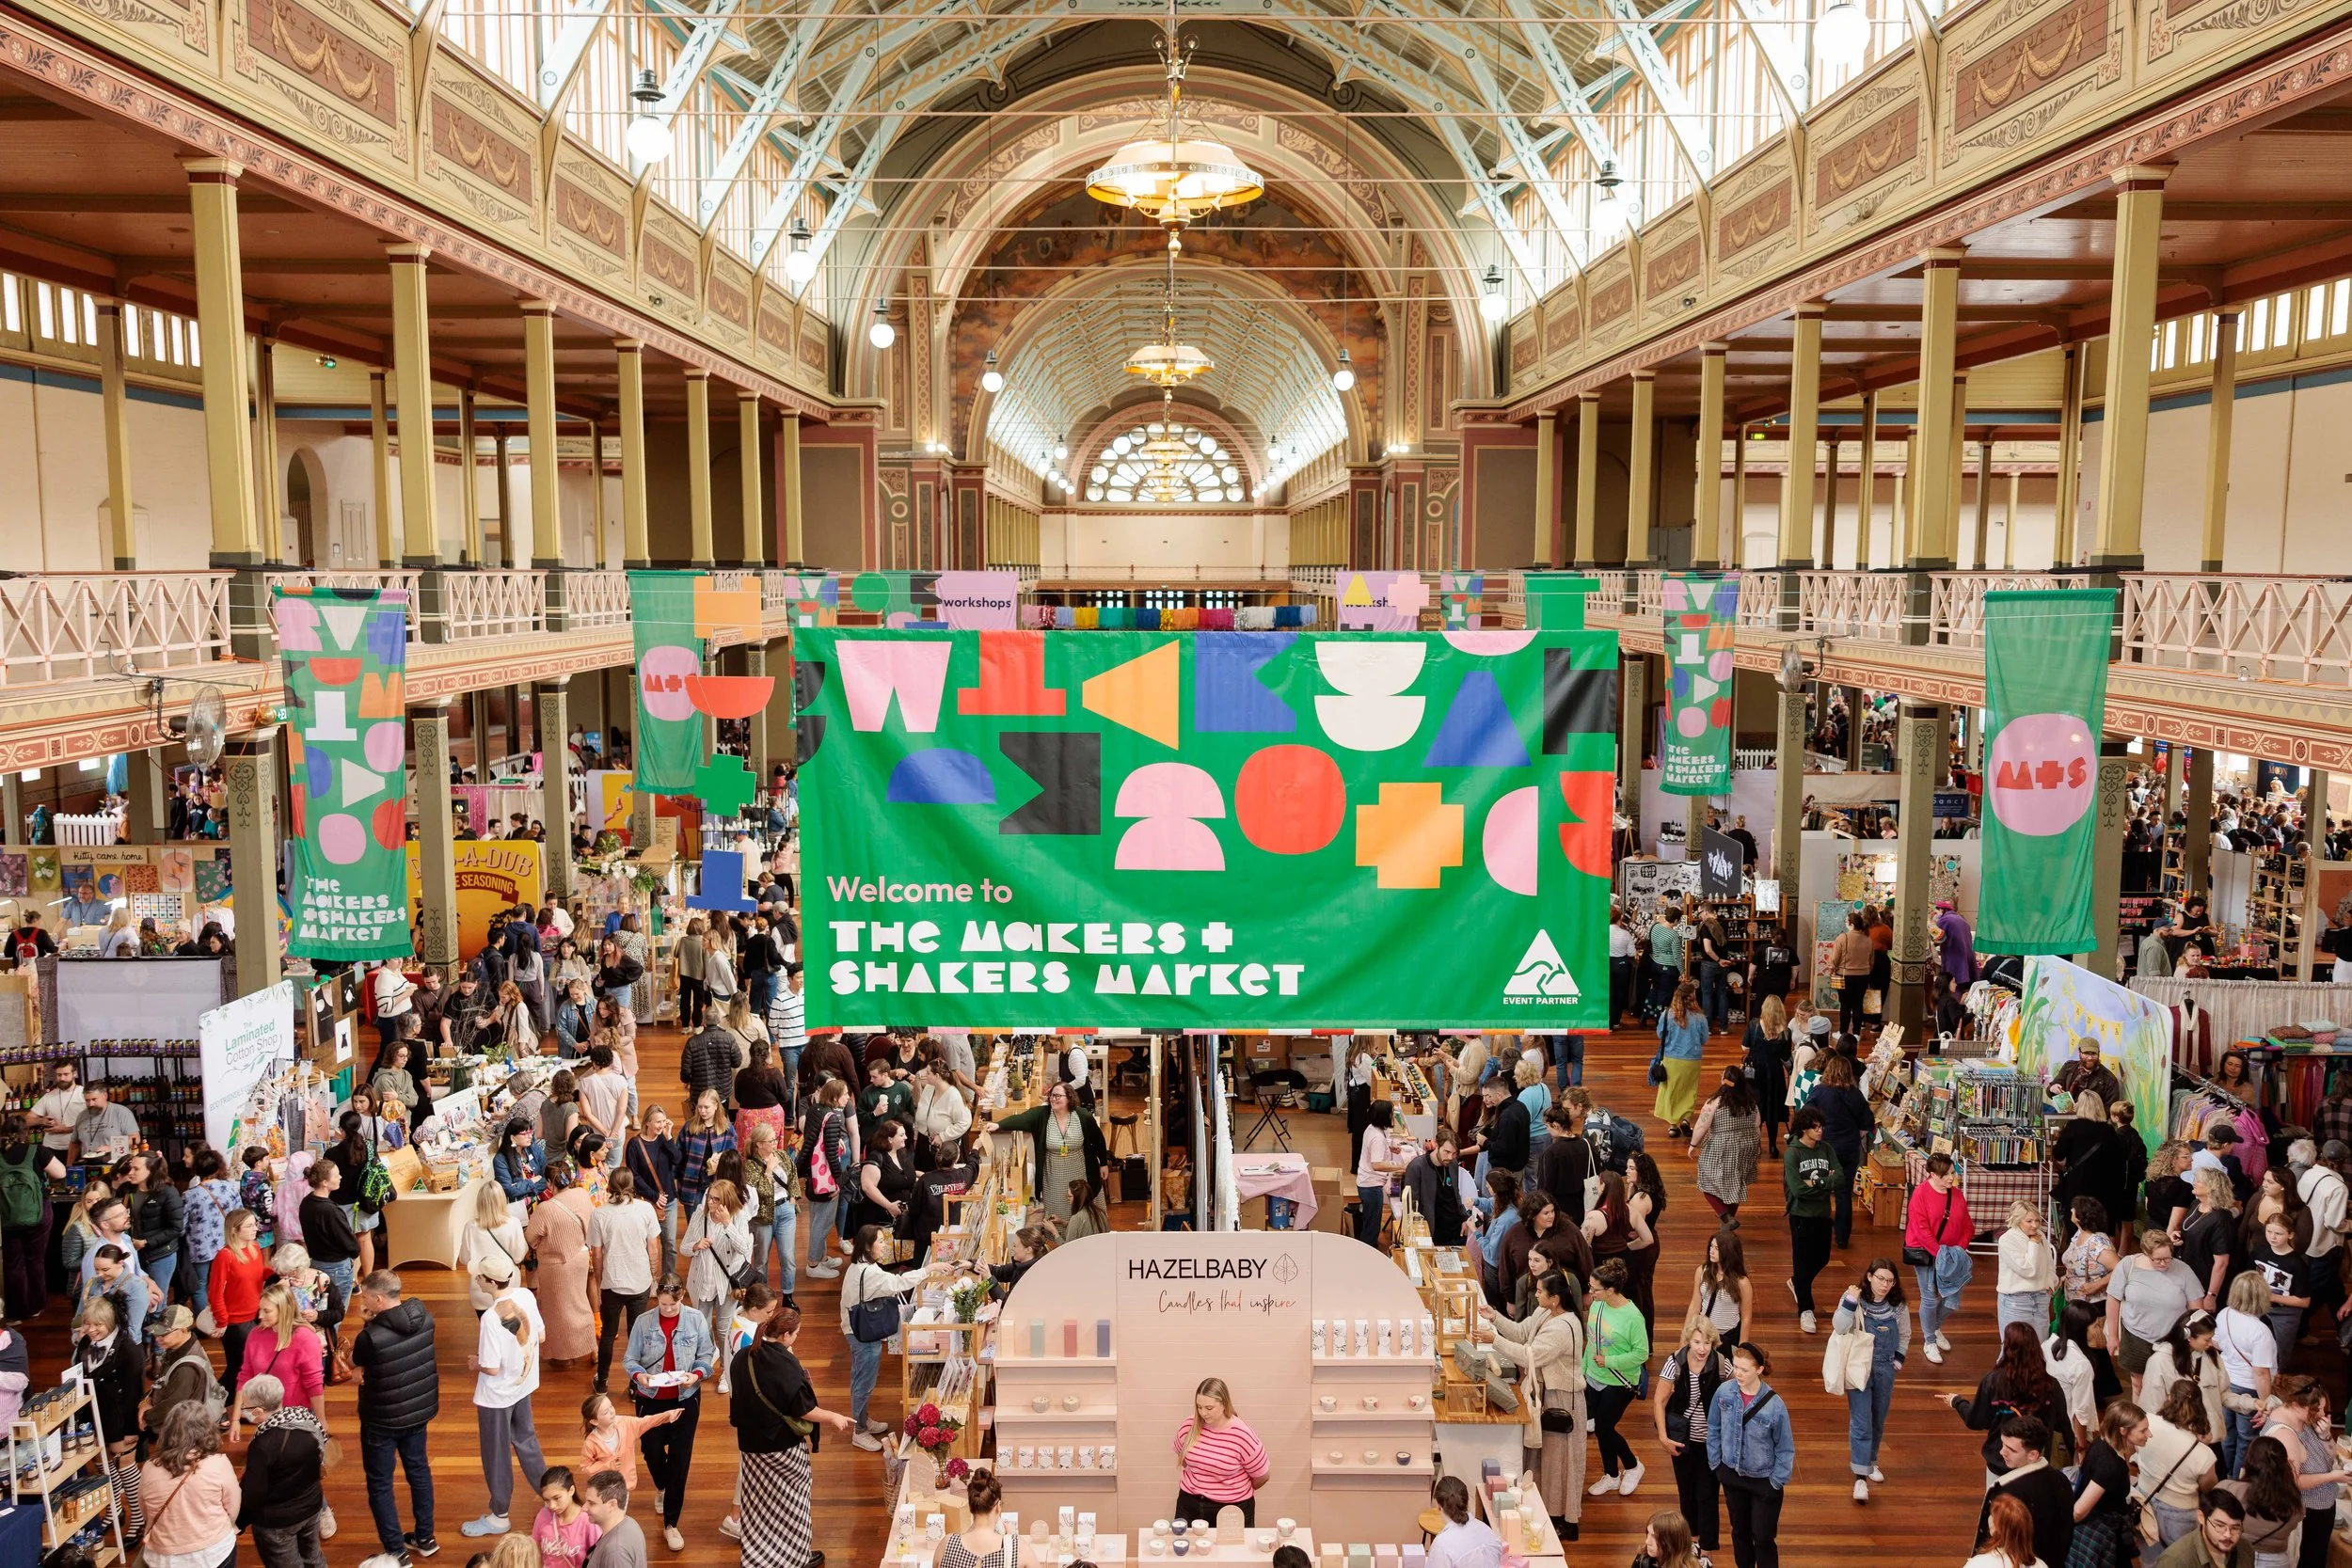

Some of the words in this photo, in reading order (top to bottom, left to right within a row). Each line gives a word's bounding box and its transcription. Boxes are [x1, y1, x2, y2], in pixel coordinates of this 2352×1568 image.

[944, 596, 1011, 610] workshops
[1996, 756, 2087, 789] M+S
[121, 851, 143, 860] home
[461, 874, 514, 894] SEASONING
[826, 876, 974, 903] Welcome
[980, 878, 1013, 904] to
[226, 1018, 275, 1052] Laminated
[226, 1045, 255, 1066] Cotton
[257, 1034, 278, 1052] Shop
[1129, 1259, 1268, 1279] HAZELBABY
[1158, 1289, 1214, 1315] Candles
[1220, 1289, 1242, 1312] that
[1249, 1293, 1296, 1316] inspire
